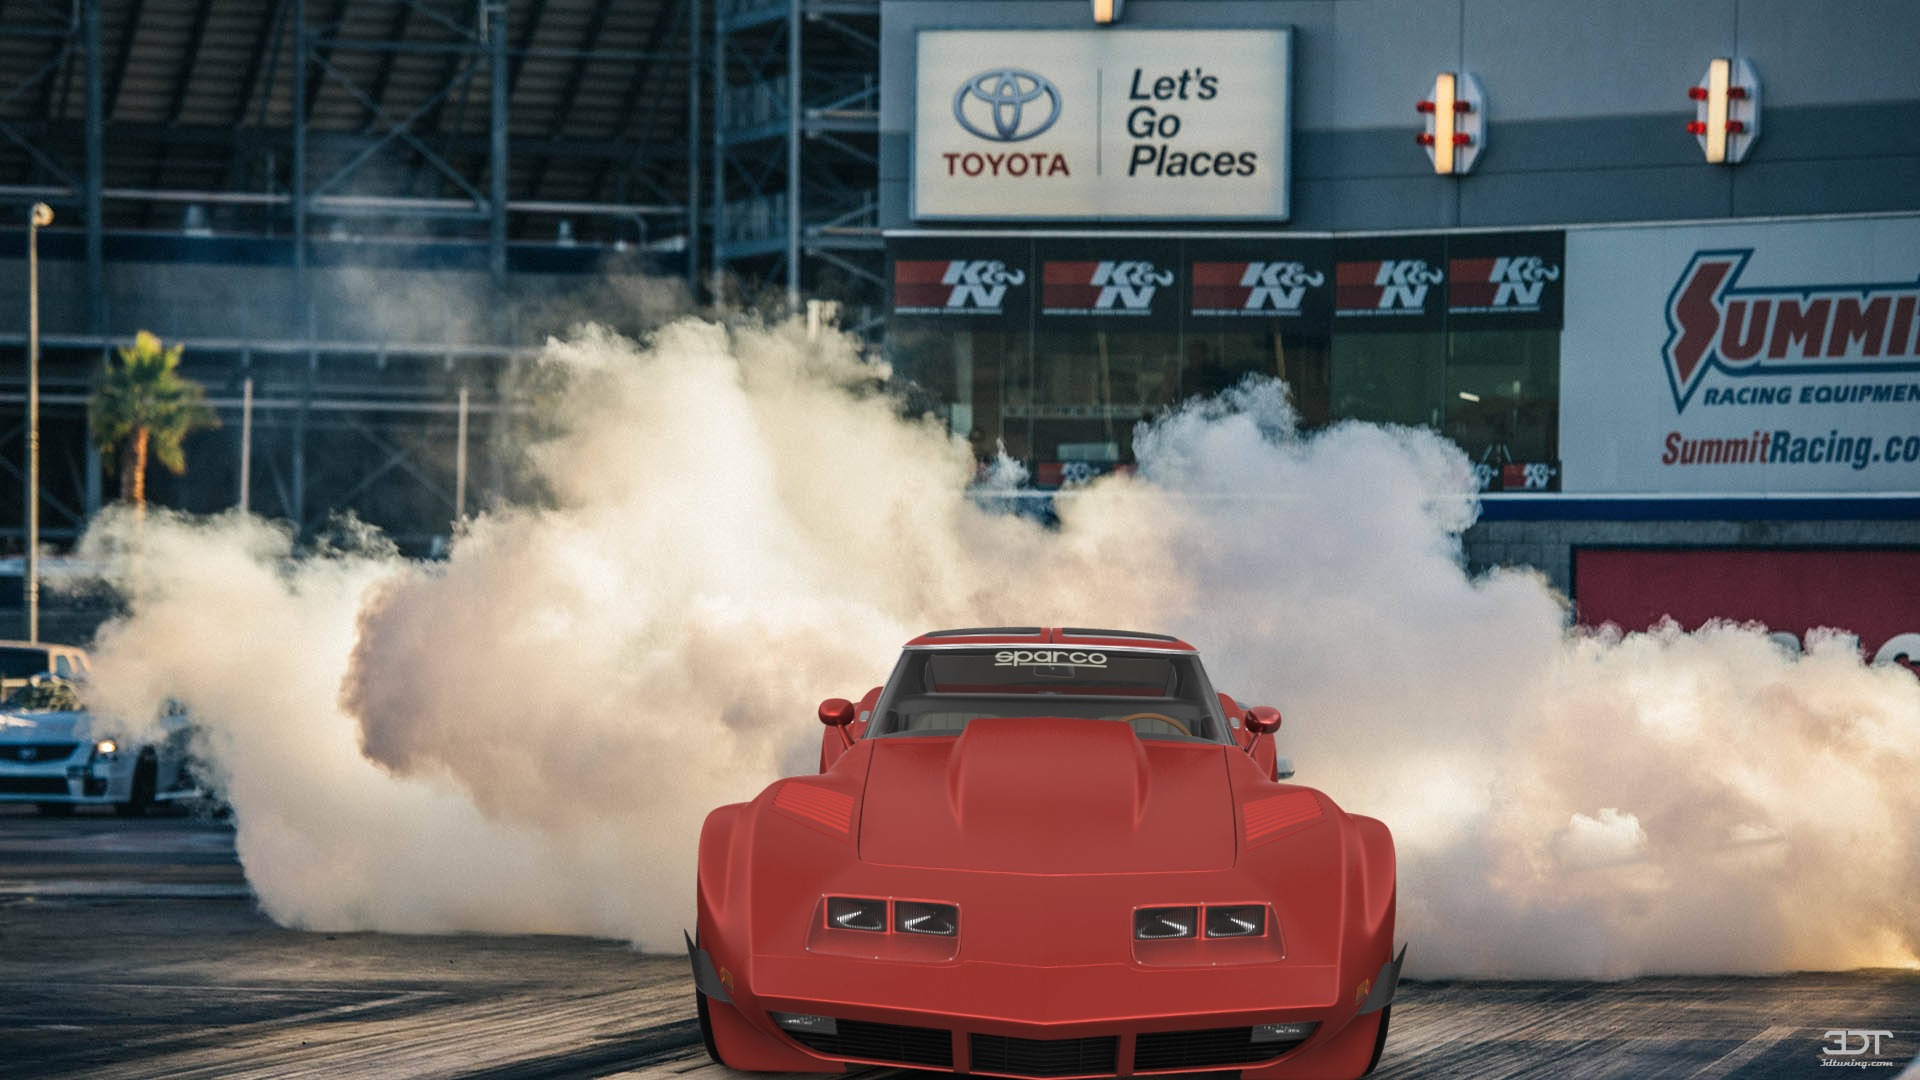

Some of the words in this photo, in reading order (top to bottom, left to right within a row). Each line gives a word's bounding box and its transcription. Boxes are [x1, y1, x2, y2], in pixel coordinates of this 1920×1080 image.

[1129, 68, 1219, 101] Let's
[1127, 106, 1182, 140] Go
[943, 152, 1071, 177] TOYOTA
[1128, 145, 1258, 178] Places
[1669, 255, 1920, 391] SUMMI
[1704, 387, 1793, 405] RACING
[995, 651, 1107, 668] sparco
